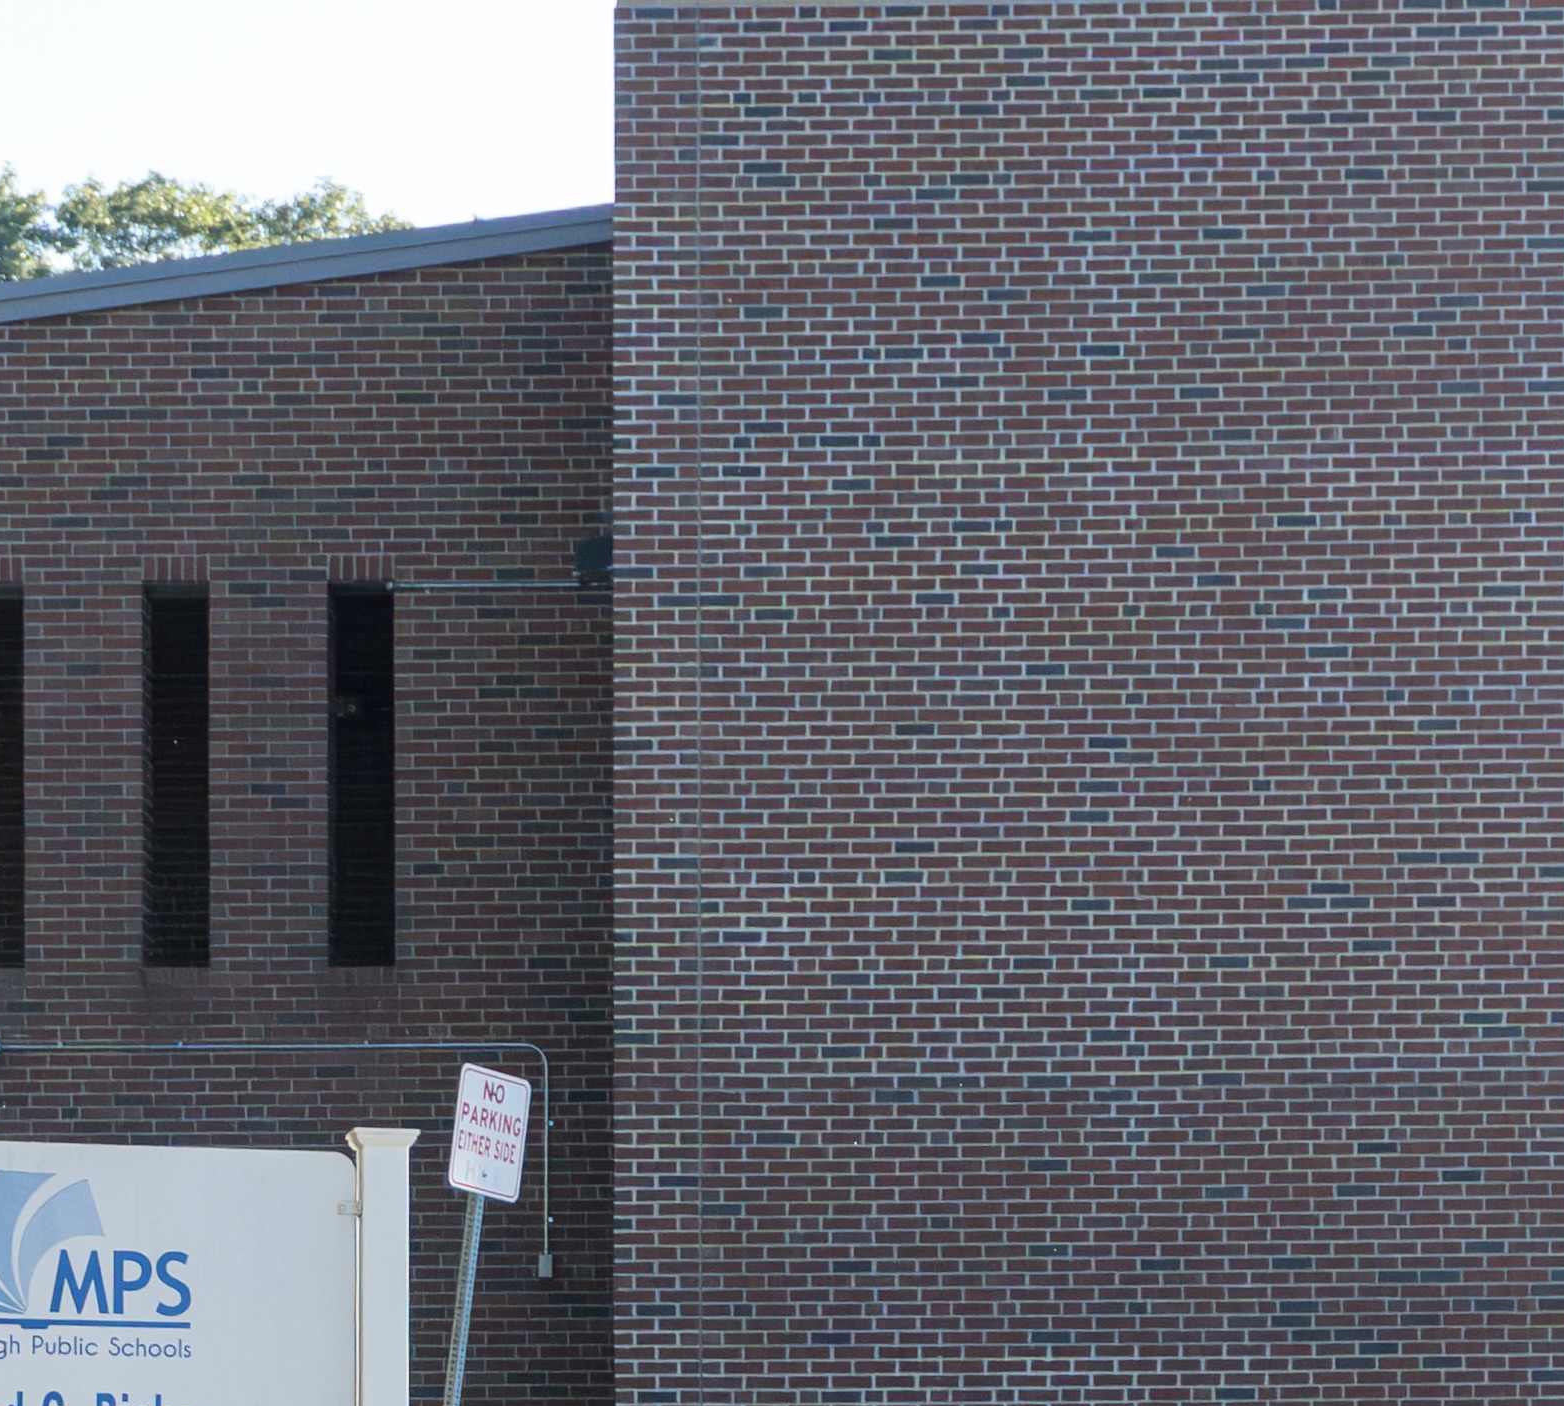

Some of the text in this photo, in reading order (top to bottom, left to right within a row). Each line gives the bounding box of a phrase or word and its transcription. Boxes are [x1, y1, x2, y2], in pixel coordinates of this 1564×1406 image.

[483, 1079, 505, 1104] NO
[461, 1102, 522, 1137] PARKING
[457, 1129, 517, 1165] EITHER SIDE
[49, 1248, 192, 1318] MPS
[31, 1333, 99, 1358] Public
[108, 1336, 192, 1359] Schools
